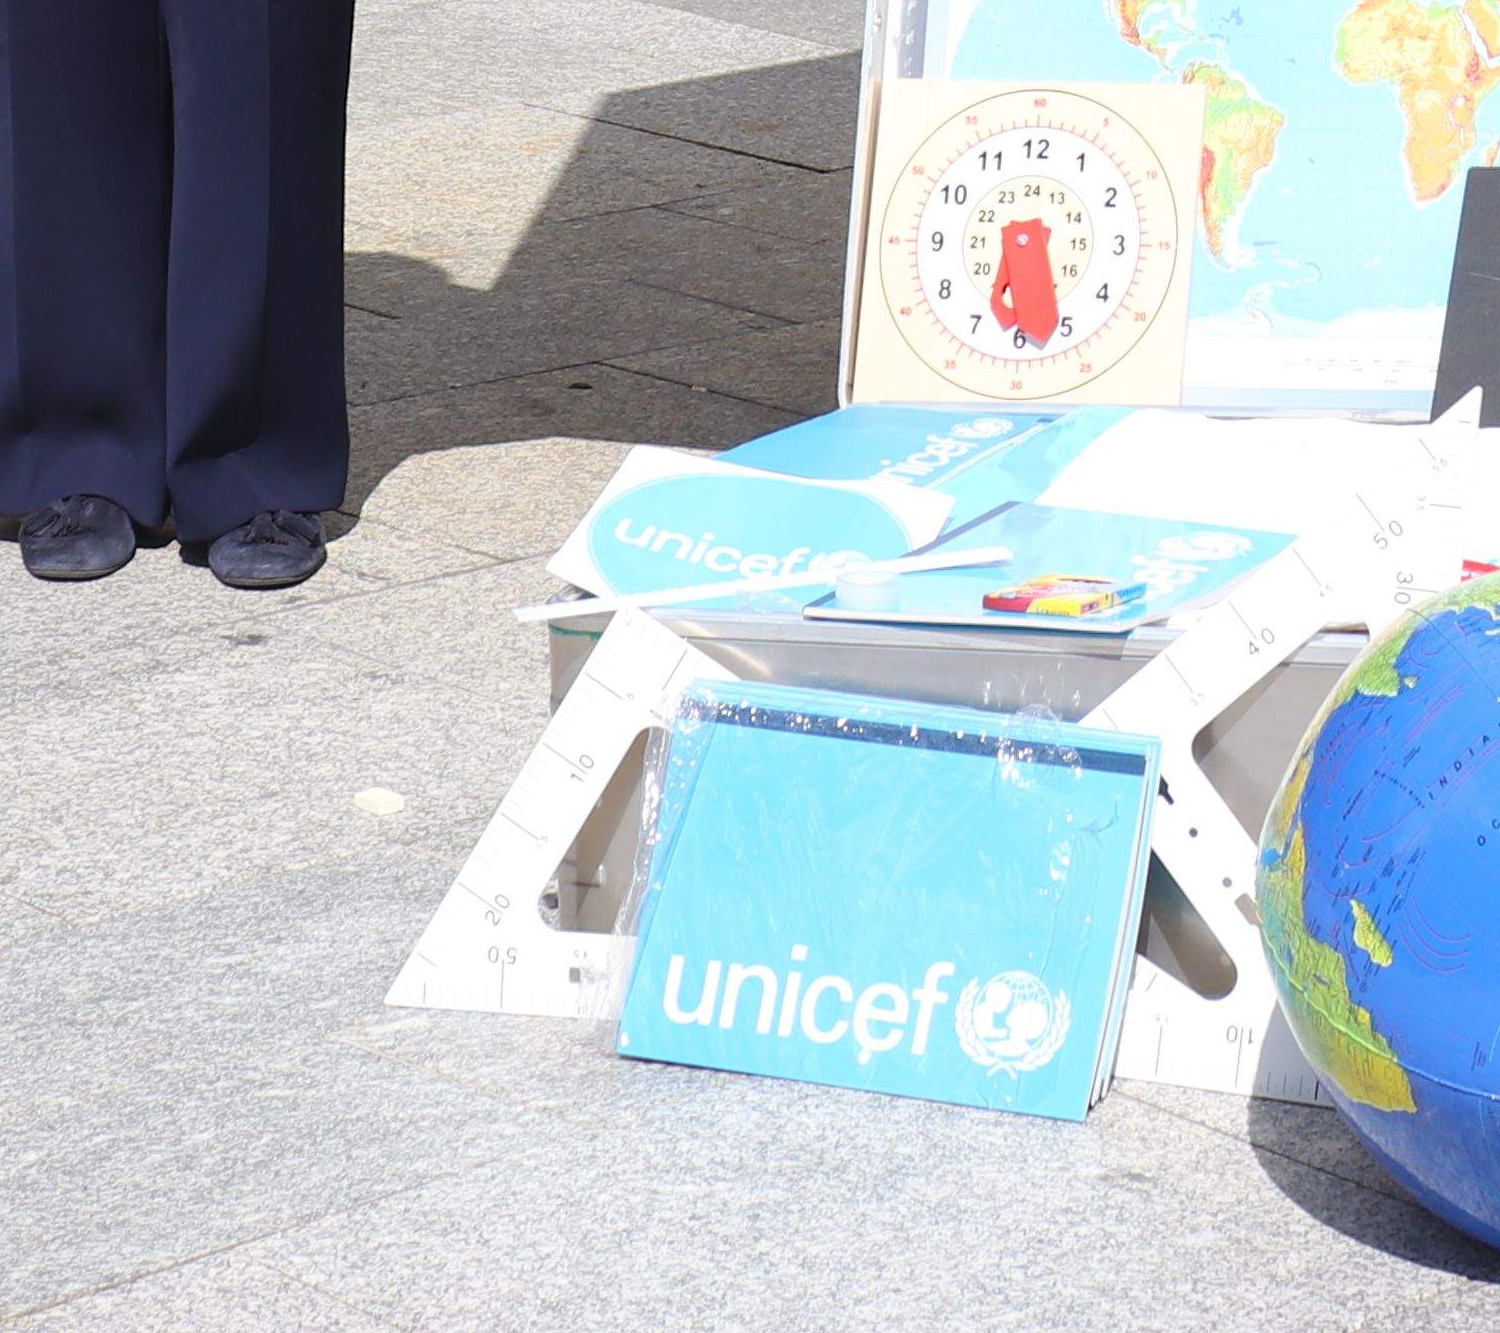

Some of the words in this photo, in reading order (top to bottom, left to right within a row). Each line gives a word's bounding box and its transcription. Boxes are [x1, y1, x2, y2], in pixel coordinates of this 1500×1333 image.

[1022, 138, 1050, 160] 12
[977, 151, 1002, 171] 11
[1075, 152, 1086, 173] 1
[940, 184, 967, 205] 10
[998, 190, 1016, 204] 23
[1023, 183, 1041, 197] 24
[1049, 191, 1066, 205] 13
[1103, 187, 1117, 208] 2
[978, 209, 995, 223] 22
[1066, 211, 1082, 224] 14
[931, 231, 944, 252] 9
[970, 236, 986, 249] 21
[1070, 237, 1087, 251] 15
[1112, 234, 1126, 255] 3
[973, 262, 991, 276] 20
[1061, 264, 1078, 278] 16
[937, 278, 952, 299] 8
[1095, 282, 1110, 303] 4
[969, 314, 982, 335] 7
[1059, 316, 1073, 337] 5
[1012, 328, 1026, 349] 6
[1373, 519, 1404, 551] 50
[613, 514, 820, 579] unicef
[1394, 570, 1414, 605] 30
[1247, 627, 1276, 657] 40
[569, 753, 594, 784] 10
[484, 893, 510, 927] 20
[661, 943, 958, 1057] unicef
